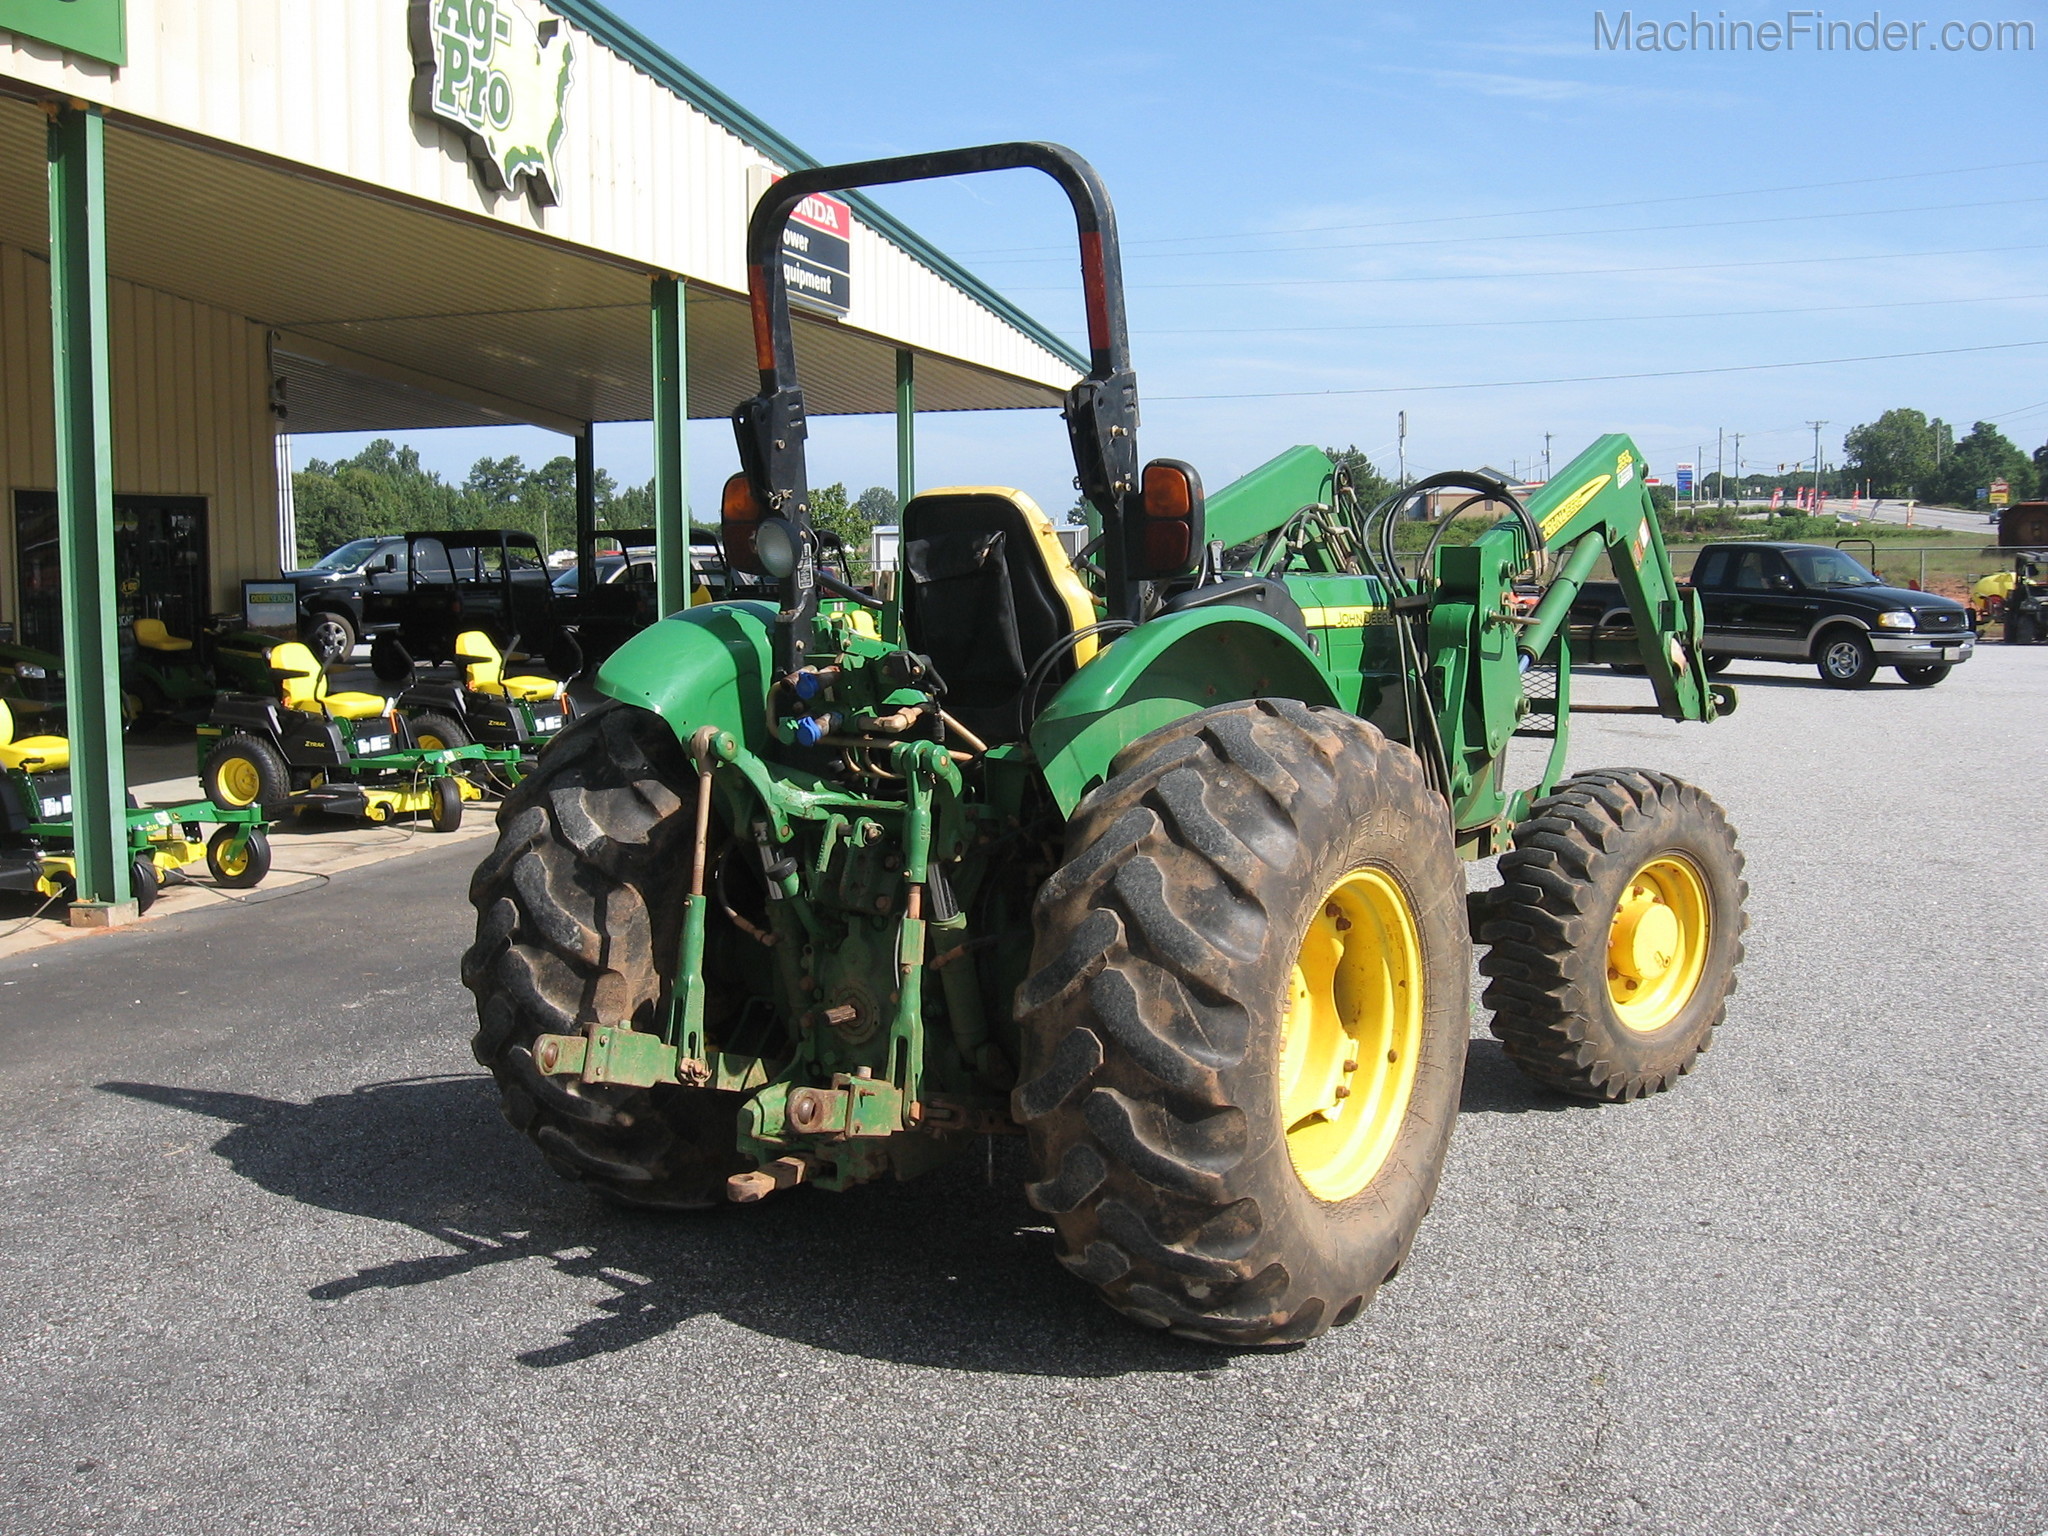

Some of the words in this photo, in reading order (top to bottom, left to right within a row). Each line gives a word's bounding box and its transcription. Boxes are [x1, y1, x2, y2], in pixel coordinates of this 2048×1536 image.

[438, 0, 509, 62] Ag-
[439, 33, 511, 125] Pro
[794, 196, 839, 230] NDA
[782, 227, 810, 253] ower
[783, 261, 832, 295] quipment
[1336, 611, 1363, 627] JOHN
